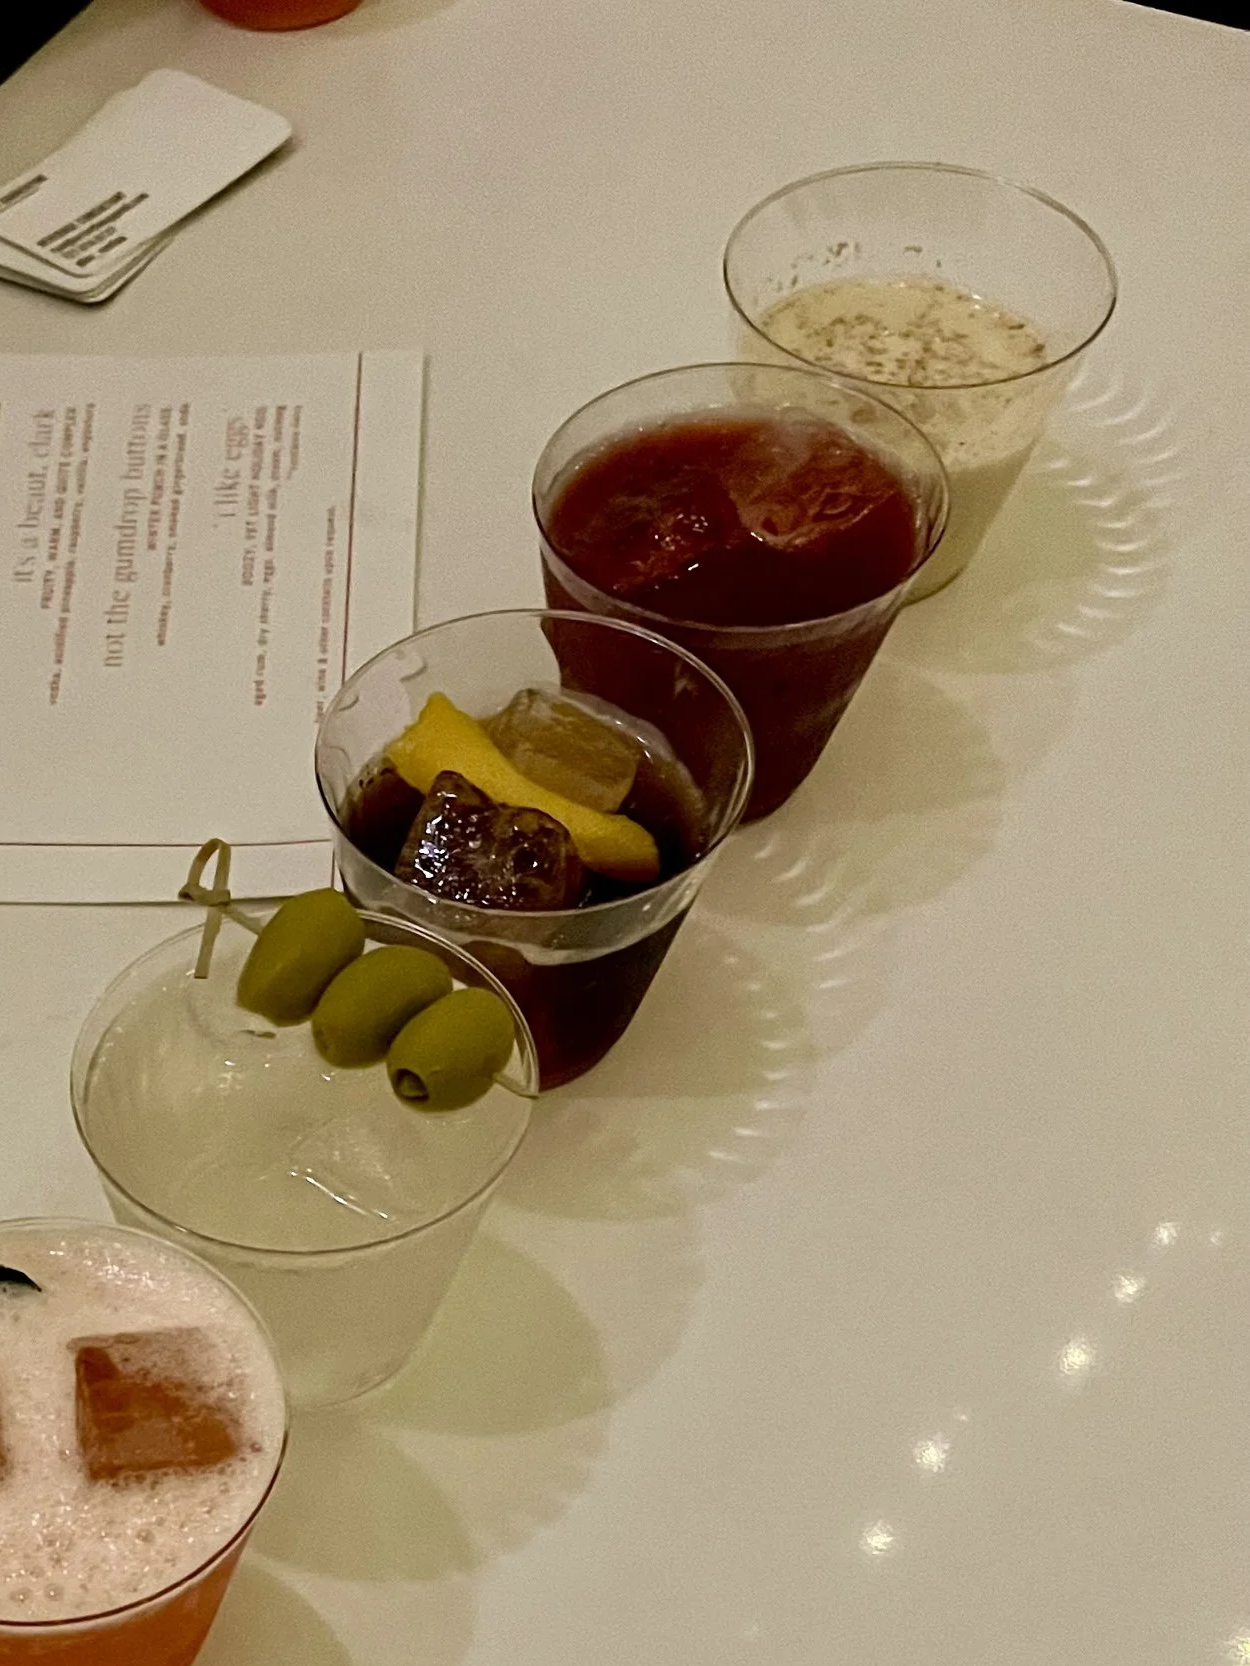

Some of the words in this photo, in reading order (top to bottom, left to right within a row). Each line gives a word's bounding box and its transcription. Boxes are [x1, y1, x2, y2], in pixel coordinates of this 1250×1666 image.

[27, 409, 55, 459] clark
[119, 403, 151, 480] buttons
[155, 453, 167, 465] IN
[250, 433, 265, 481] HOLIDAY
[55, 461, 71, 495] QUITE
[149, 468, 165, 506] PUNCH
[213, 467, 241, 505] like
[52, 496, 66, 520] AND
[246, 483, 260, 517] LIGHT
[20, 536, 39, 549] a
[113, 487, 146, 583] gumdrop
[146, 509, 161, 551] WINTER
[244, 520, 258, 541] YET
[103, 589, 131, 625] the
[103, 632, 126, 668] not
[256, 627, 270, 647] dry
[253, 678, 267, 706] aged
